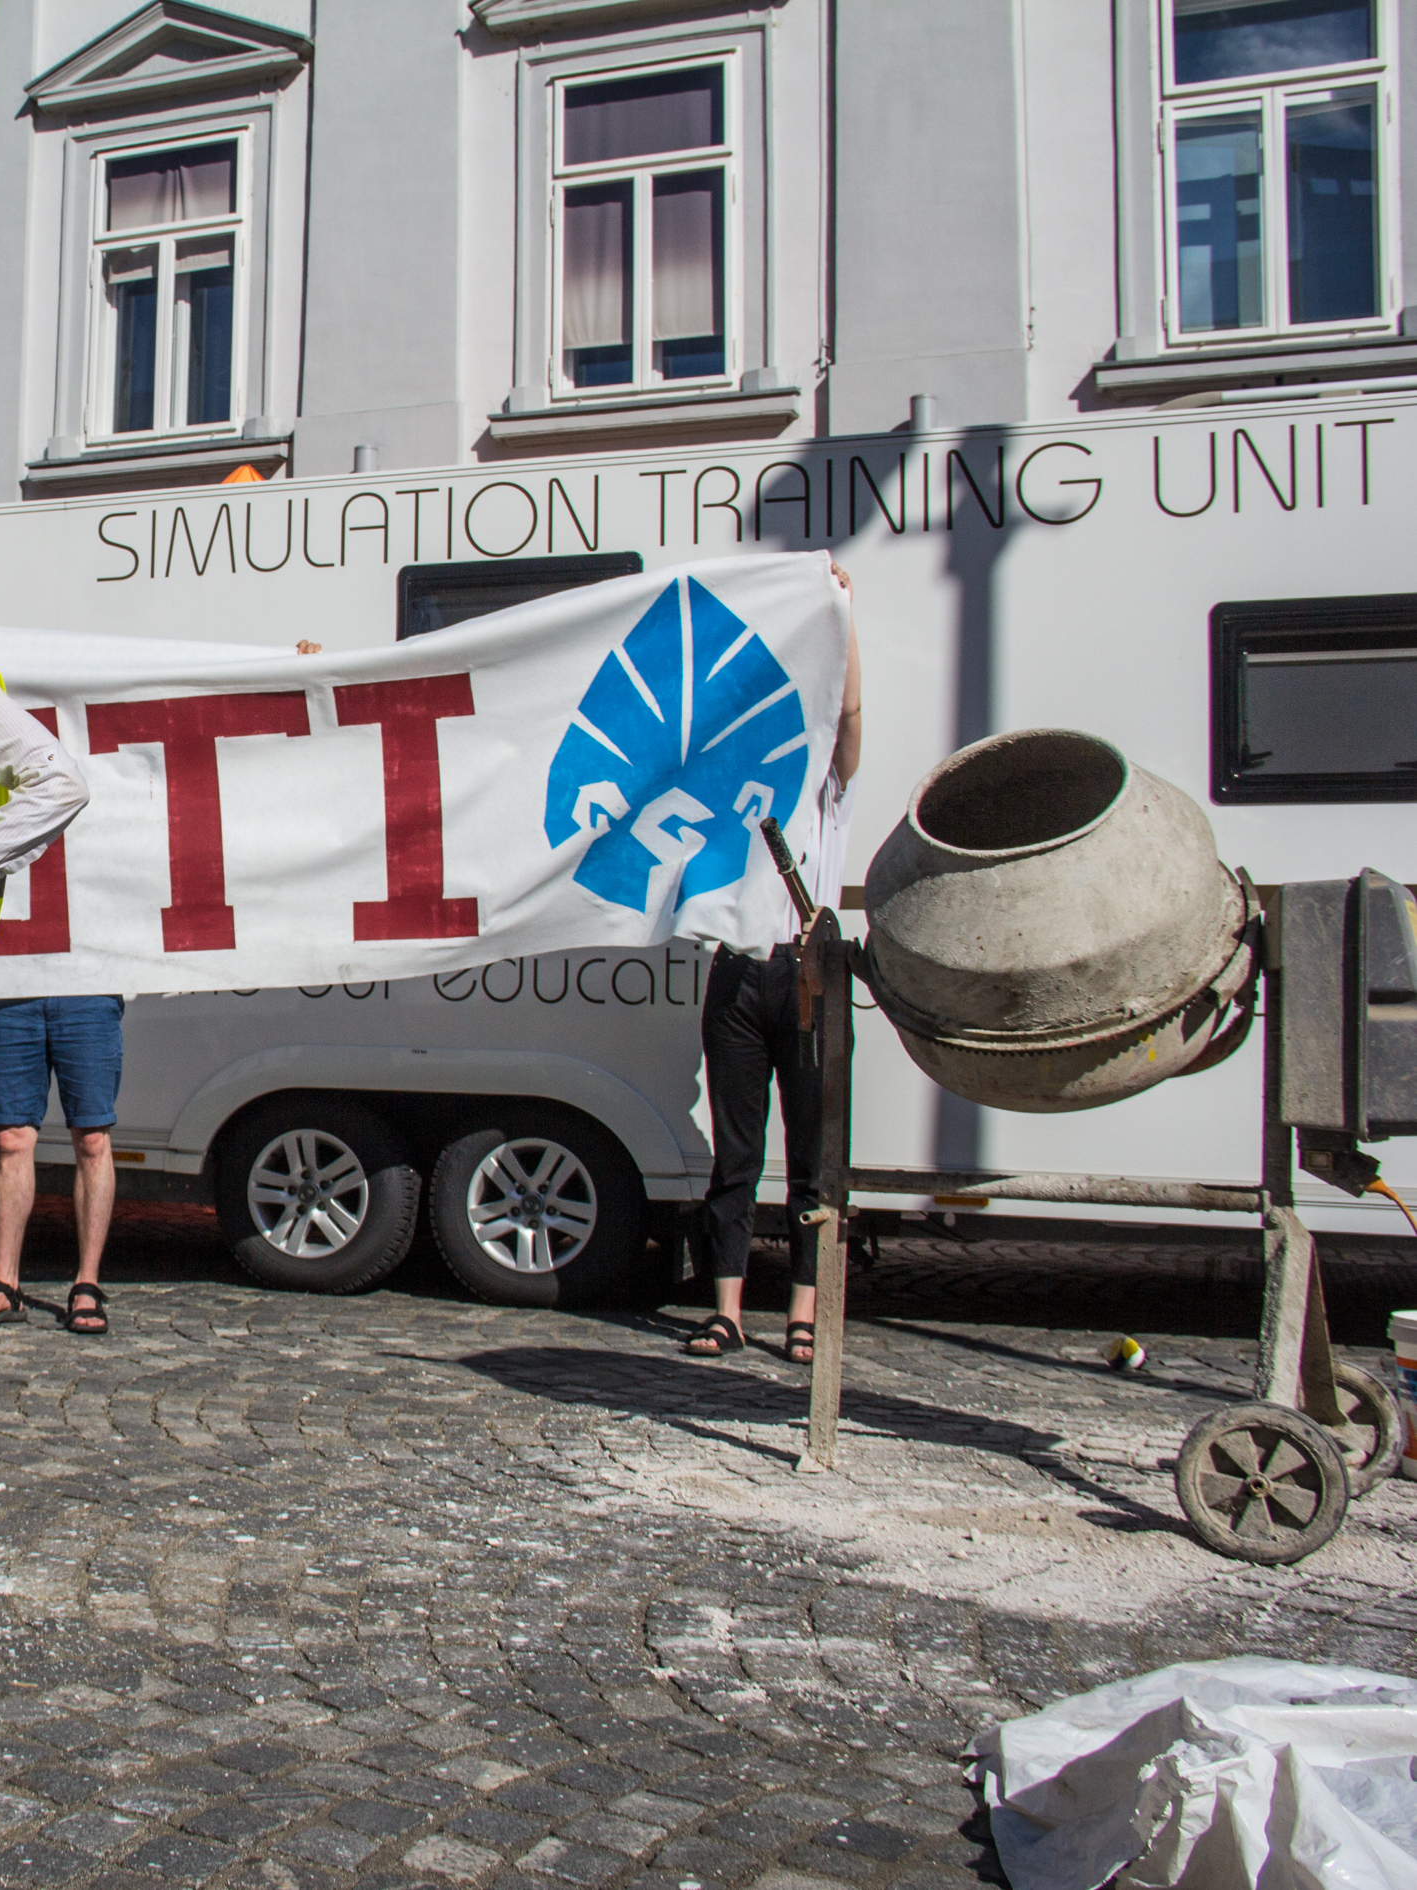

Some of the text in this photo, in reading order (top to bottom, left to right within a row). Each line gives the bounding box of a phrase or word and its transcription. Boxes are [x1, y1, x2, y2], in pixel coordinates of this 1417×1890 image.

[97, 419, 1396, 582] SIMULATION TRAINING UNIT
[433, 944, 700, 1006] educati
